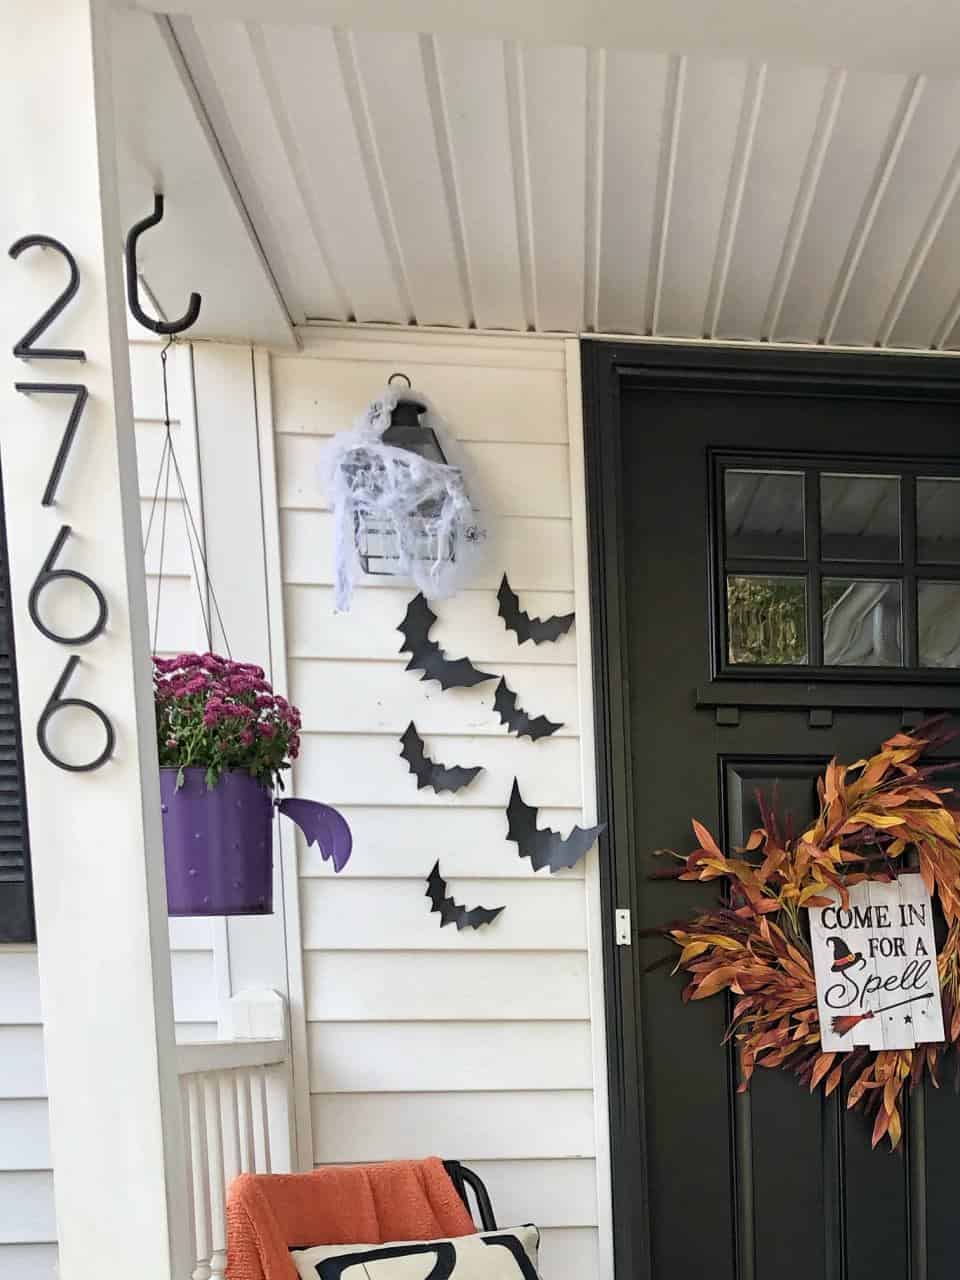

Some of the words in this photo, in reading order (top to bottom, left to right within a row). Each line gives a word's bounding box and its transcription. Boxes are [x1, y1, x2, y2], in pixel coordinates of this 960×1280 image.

[8, 233, 115, 773] 2766
[821, 906, 891, 929] COME
[900, 904, 926, 927] IN
[868, 937, 906, 957] FOR
[915, 937, 928, 956] A
[823, 958, 932, 1009] Spell
